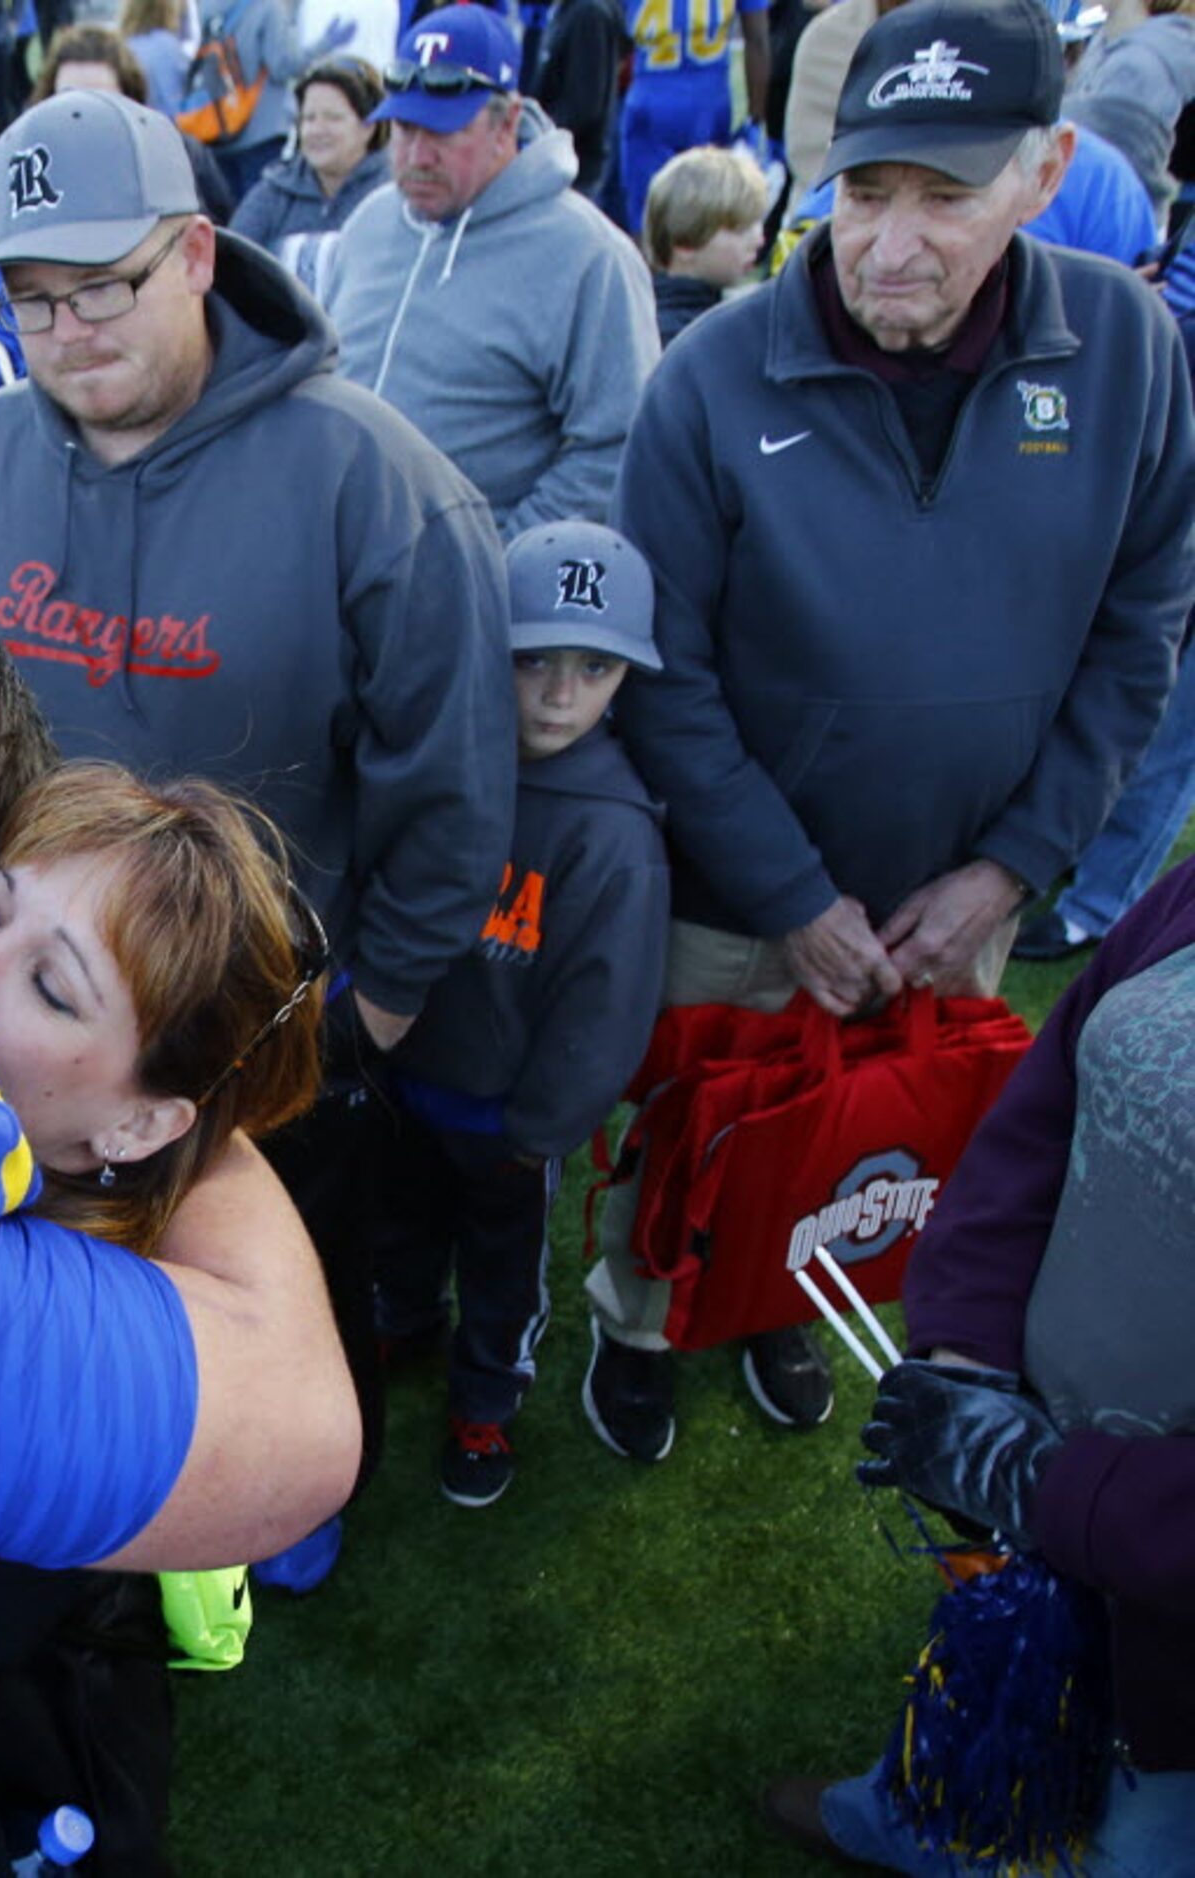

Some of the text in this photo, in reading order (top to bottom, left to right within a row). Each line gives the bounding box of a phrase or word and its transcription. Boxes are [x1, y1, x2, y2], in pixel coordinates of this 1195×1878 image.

[413, 32, 449, 68] T
[631, 0, 738, 71] 40
[9, 142, 65, 219] R
[554, 558, 609, 614] R
